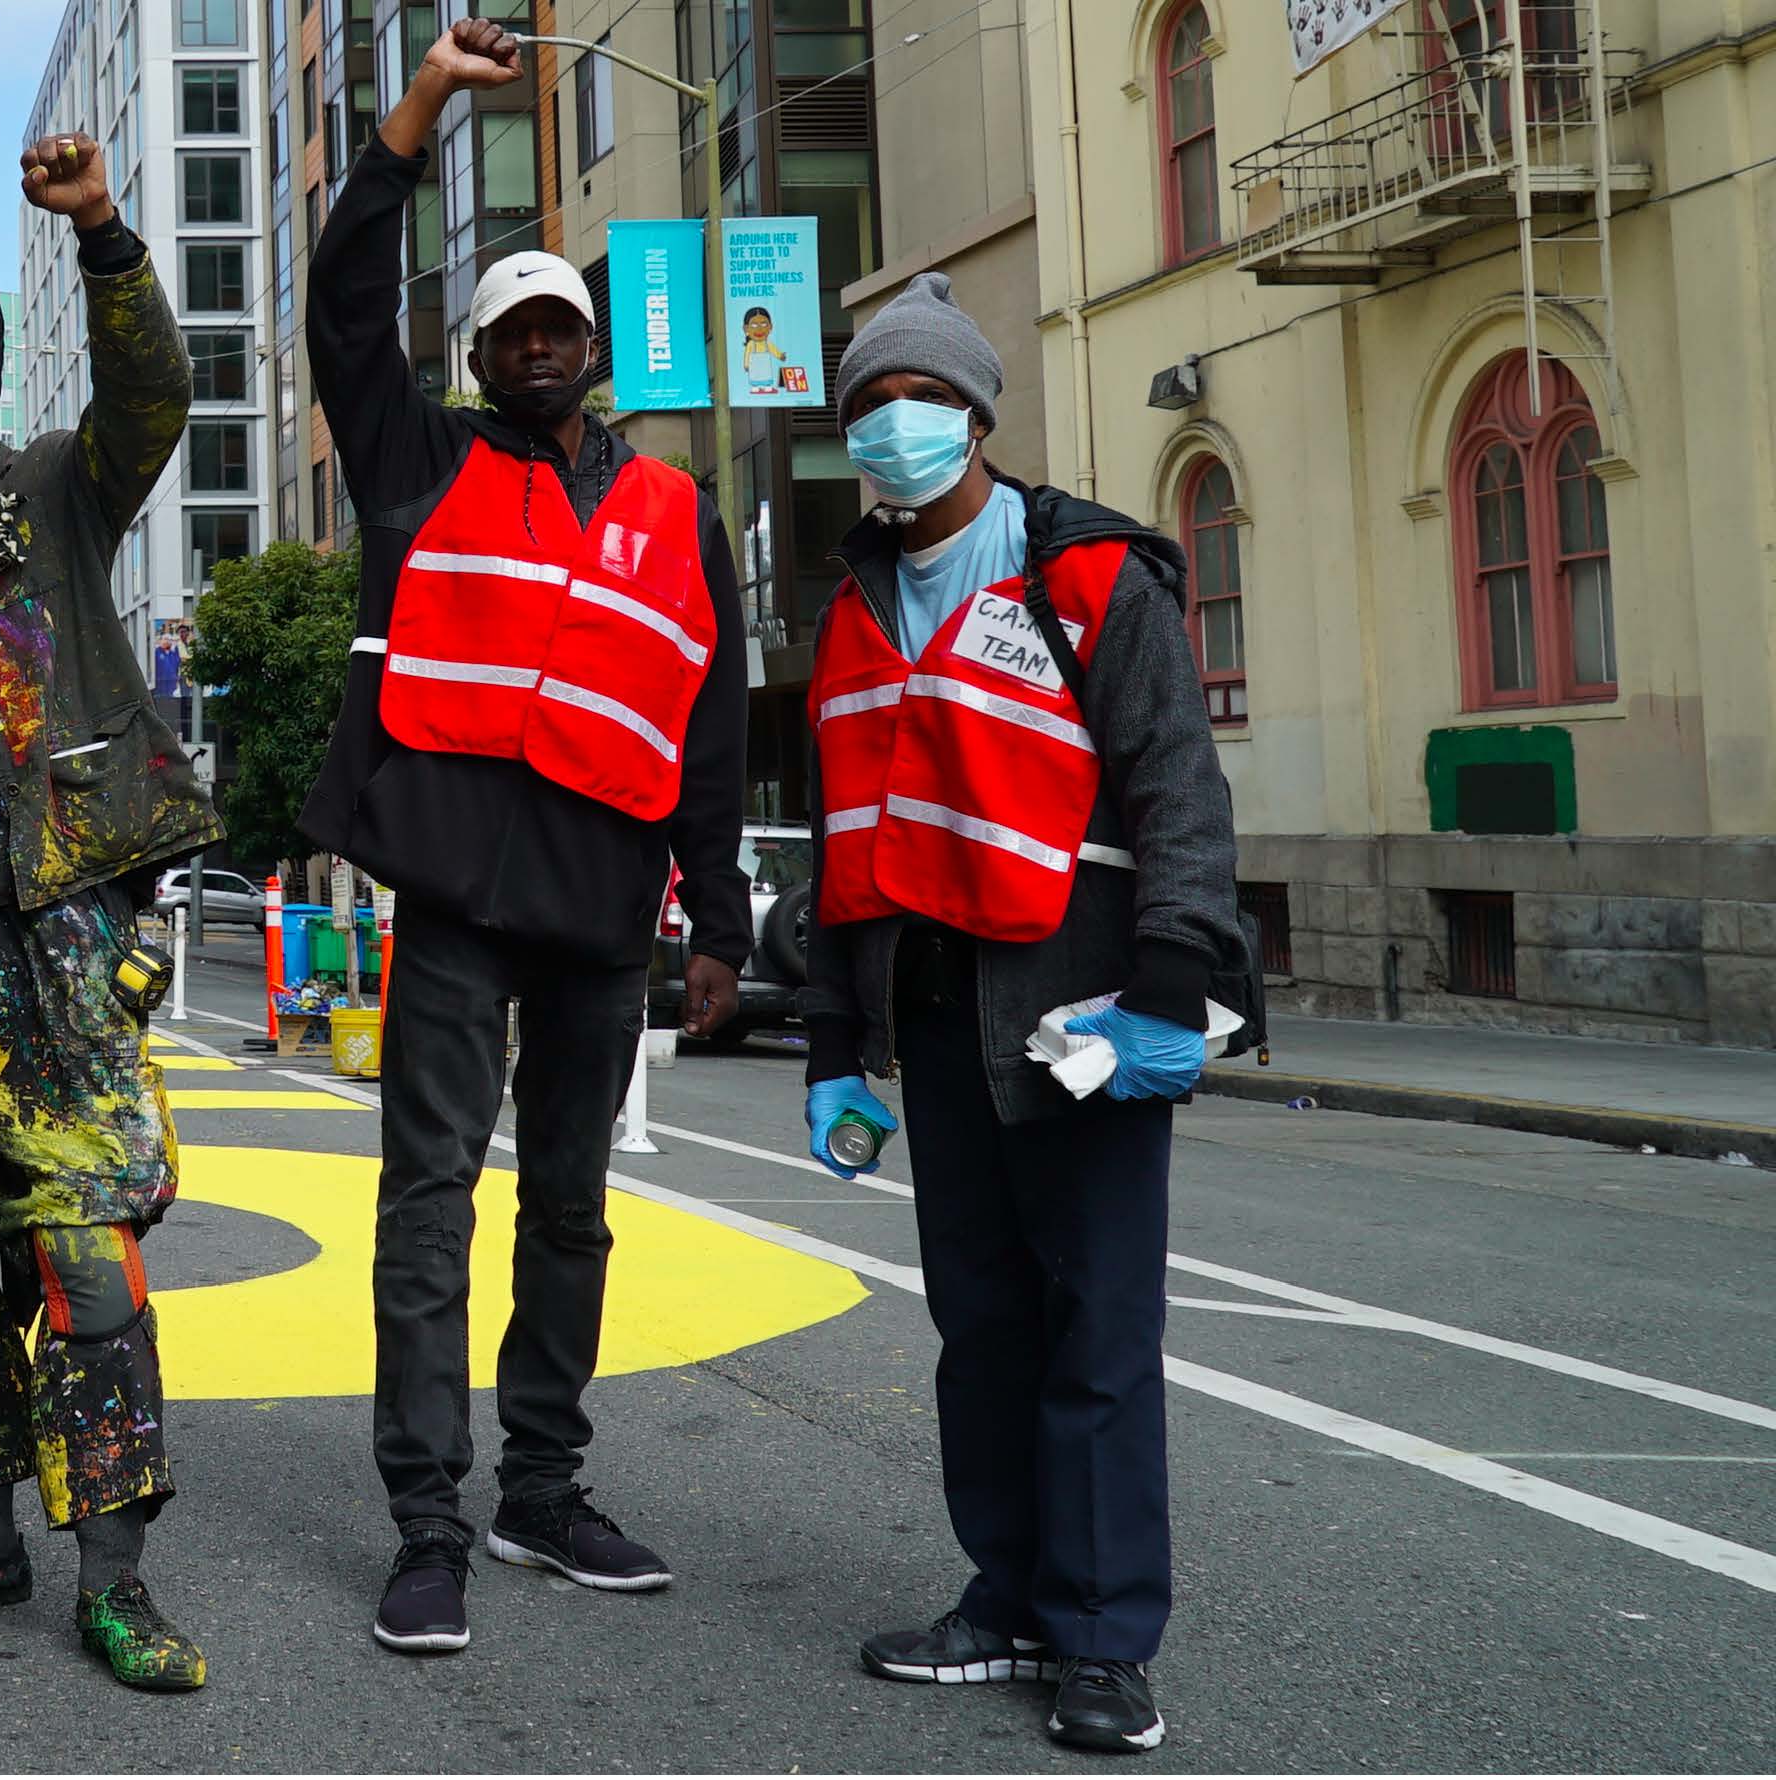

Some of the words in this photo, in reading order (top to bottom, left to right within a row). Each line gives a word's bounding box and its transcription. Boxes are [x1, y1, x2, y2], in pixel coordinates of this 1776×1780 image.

[729, 233, 771, 246] AROUND
[773, 232, 799, 245] HERE
[729, 246, 746, 258] WE
[748, 246, 774, 258] TEND
[778, 246, 790, 257] TO
[729, 259, 777, 272] SUPPORT
[730, 273, 752, 284] OUR
[754, 272, 804, 284] BUSINESS
[730, 285, 779, 298] OWNERS.
[645, 249, 673, 373] TENDERLOIN
[982, 635, 1048, 676] TEAM
